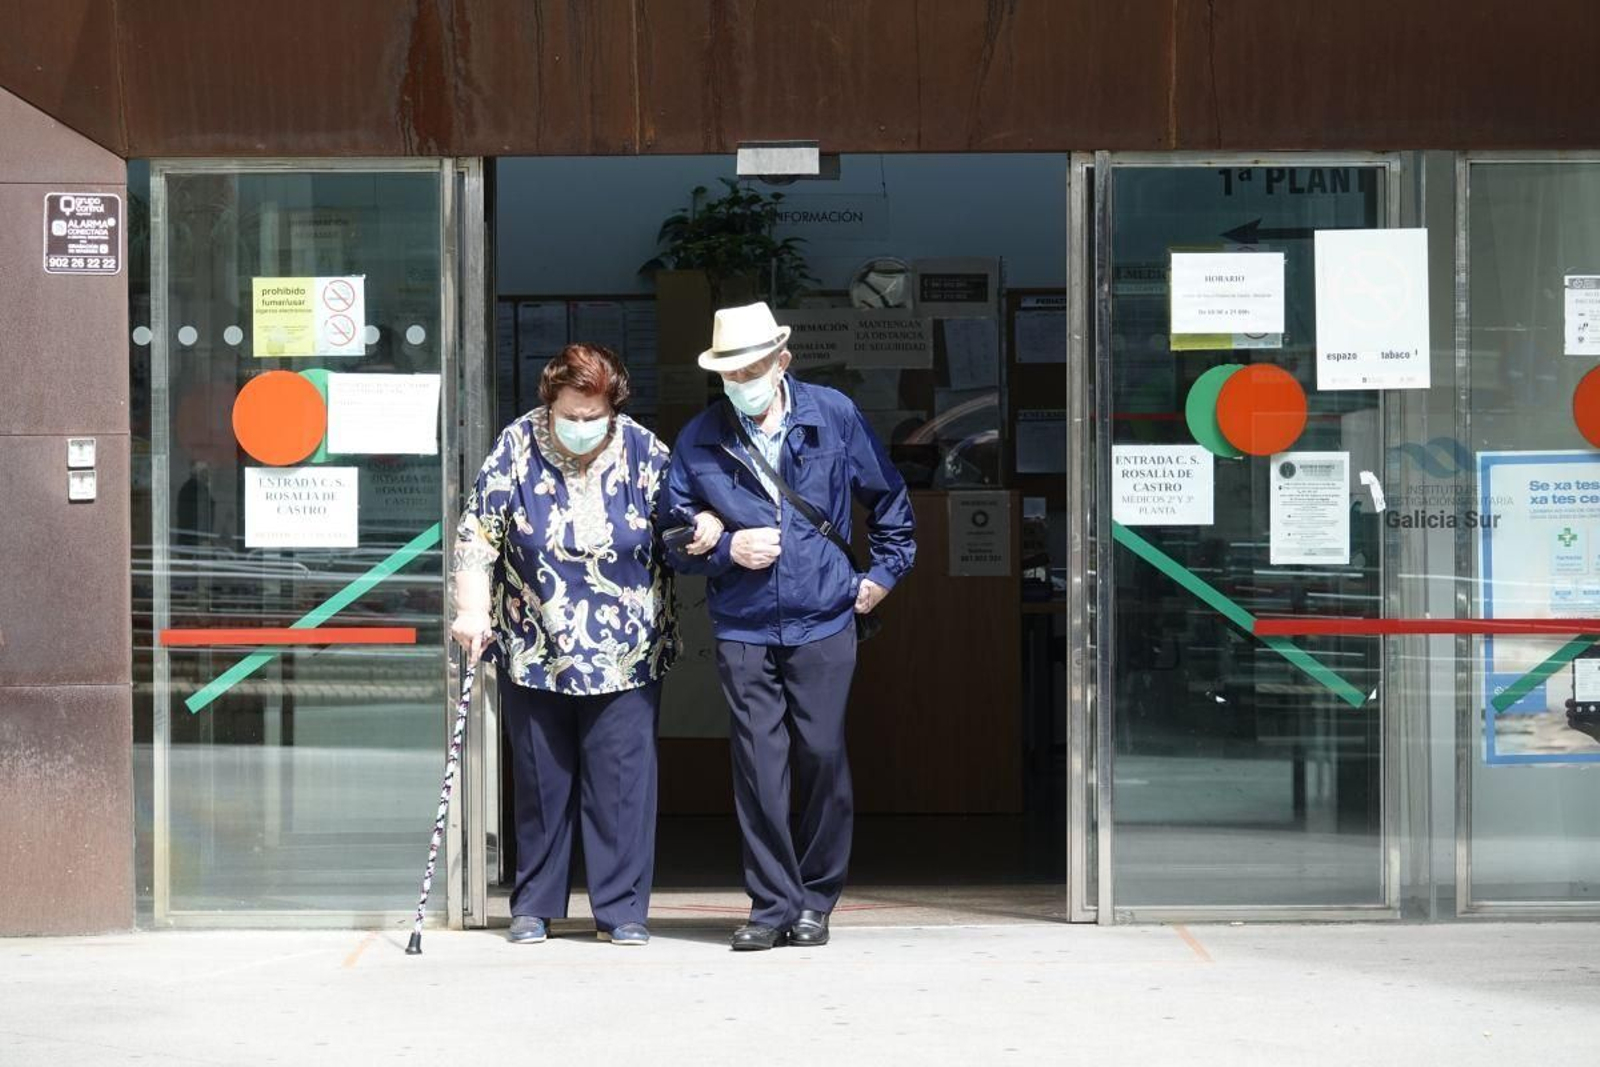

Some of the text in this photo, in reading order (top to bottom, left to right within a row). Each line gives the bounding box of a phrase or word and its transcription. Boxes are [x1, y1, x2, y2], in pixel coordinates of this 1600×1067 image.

[776, 208, 863, 222] NFORMACIÓN
[67, 219, 109, 229] ALARMA
[67, 228, 109, 236] CONECTADA
[48, 257, 116, 268] 902 26 22 22
[261, 287, 306, 297] prohibido
[261, 299, 306, 307] fumar/usar
[858, 320, 922, 329] MANTENGAN
[856, 331, 925, 340] LA DISTANCIA
[854, 343, 926, 351] DE SEGURIDAD
[1326, 349, 1411, 362] espazo tabaco
[1115, 455, 1200, 465] ENTRADA C. S.
[1121, 467, 1194, 478] ROSALÍA DE
[259, 478, 317, 488] ENTRADA
[1132, 483, 1182, 492] CASTRO
[1529, 480, 1550, 491] Se
[1554, 482, 1572, 491] xa
[1530, 495, 1548, 504] xa
[1552, 494, 1576, 504] tes
[277, 506, 327, 515] CASTRO
[1139, 507, 1176, 515] PLANTA
[1386, 510, 1502, 528] Galicia Sur
